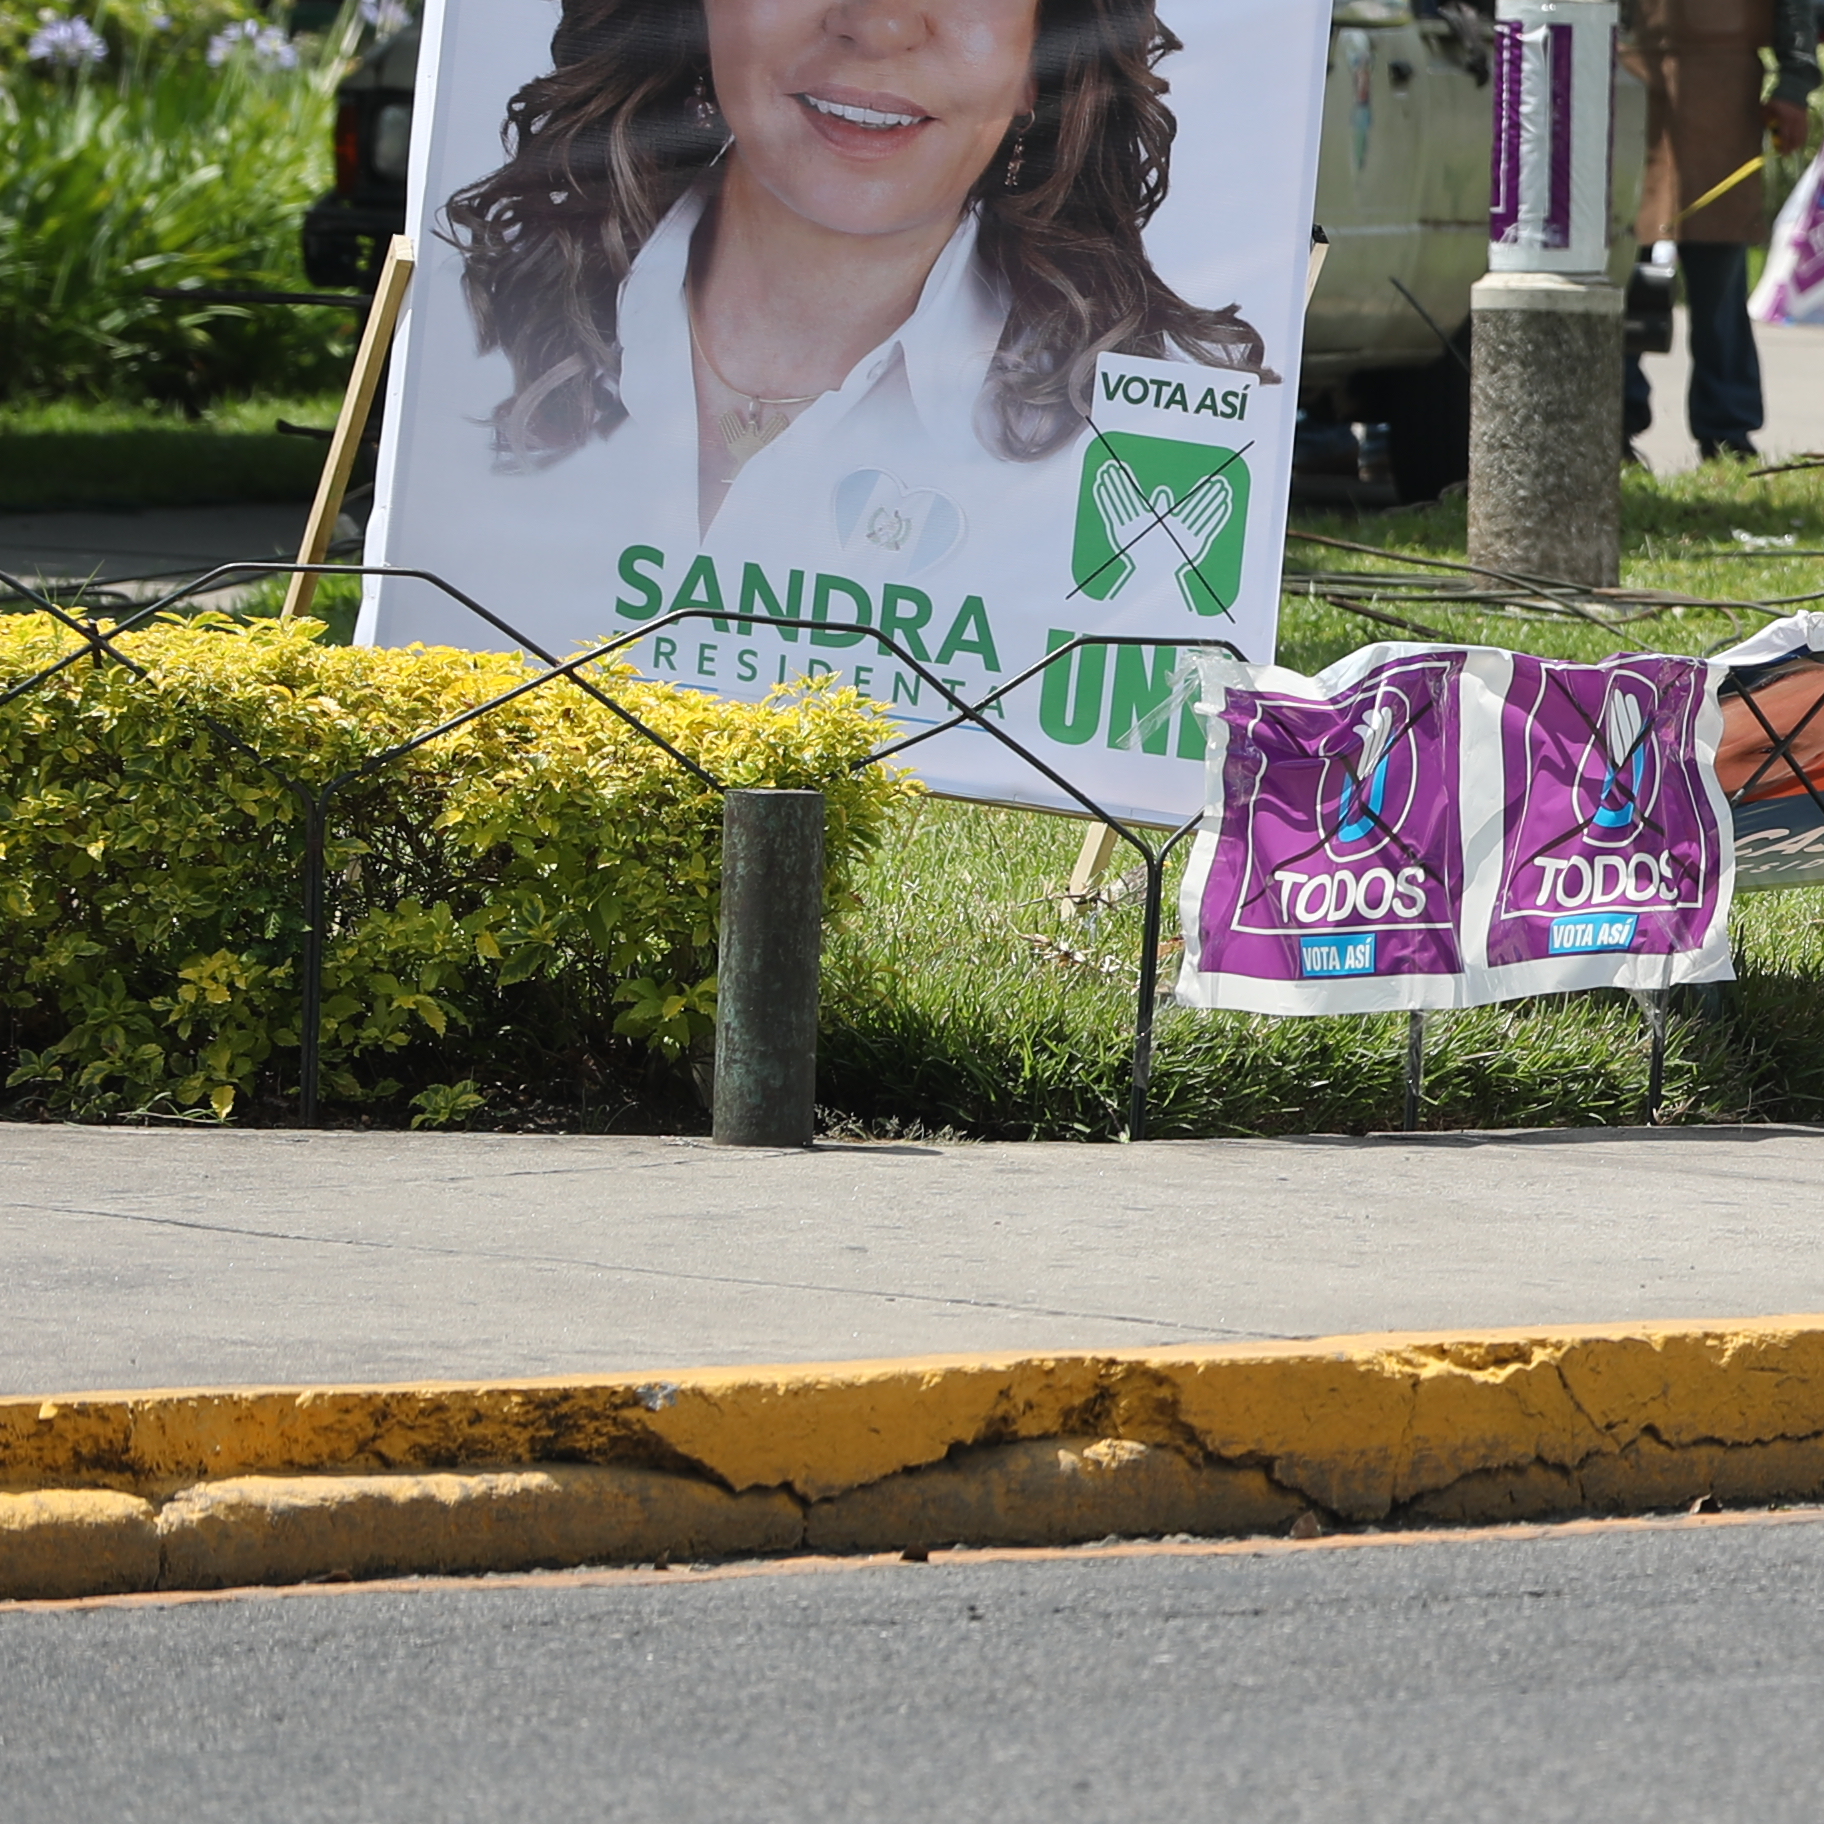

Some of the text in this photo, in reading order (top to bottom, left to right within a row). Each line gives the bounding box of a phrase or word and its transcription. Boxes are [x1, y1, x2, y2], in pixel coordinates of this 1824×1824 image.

[1101, 371, 1252, 422] VOTA ASÍ
[615, 543, 1002, 674] SANDRA
[613, 629, 1006, 720] RESIDENTA
[1273, 865, 1427, 925] TODOS
[1533, 849, 1680, 909] TODOS
[1302, 932, 1375, 973] VOTA ASÍ
[1552, 913, 1632, 951] VOTA ASÍ
